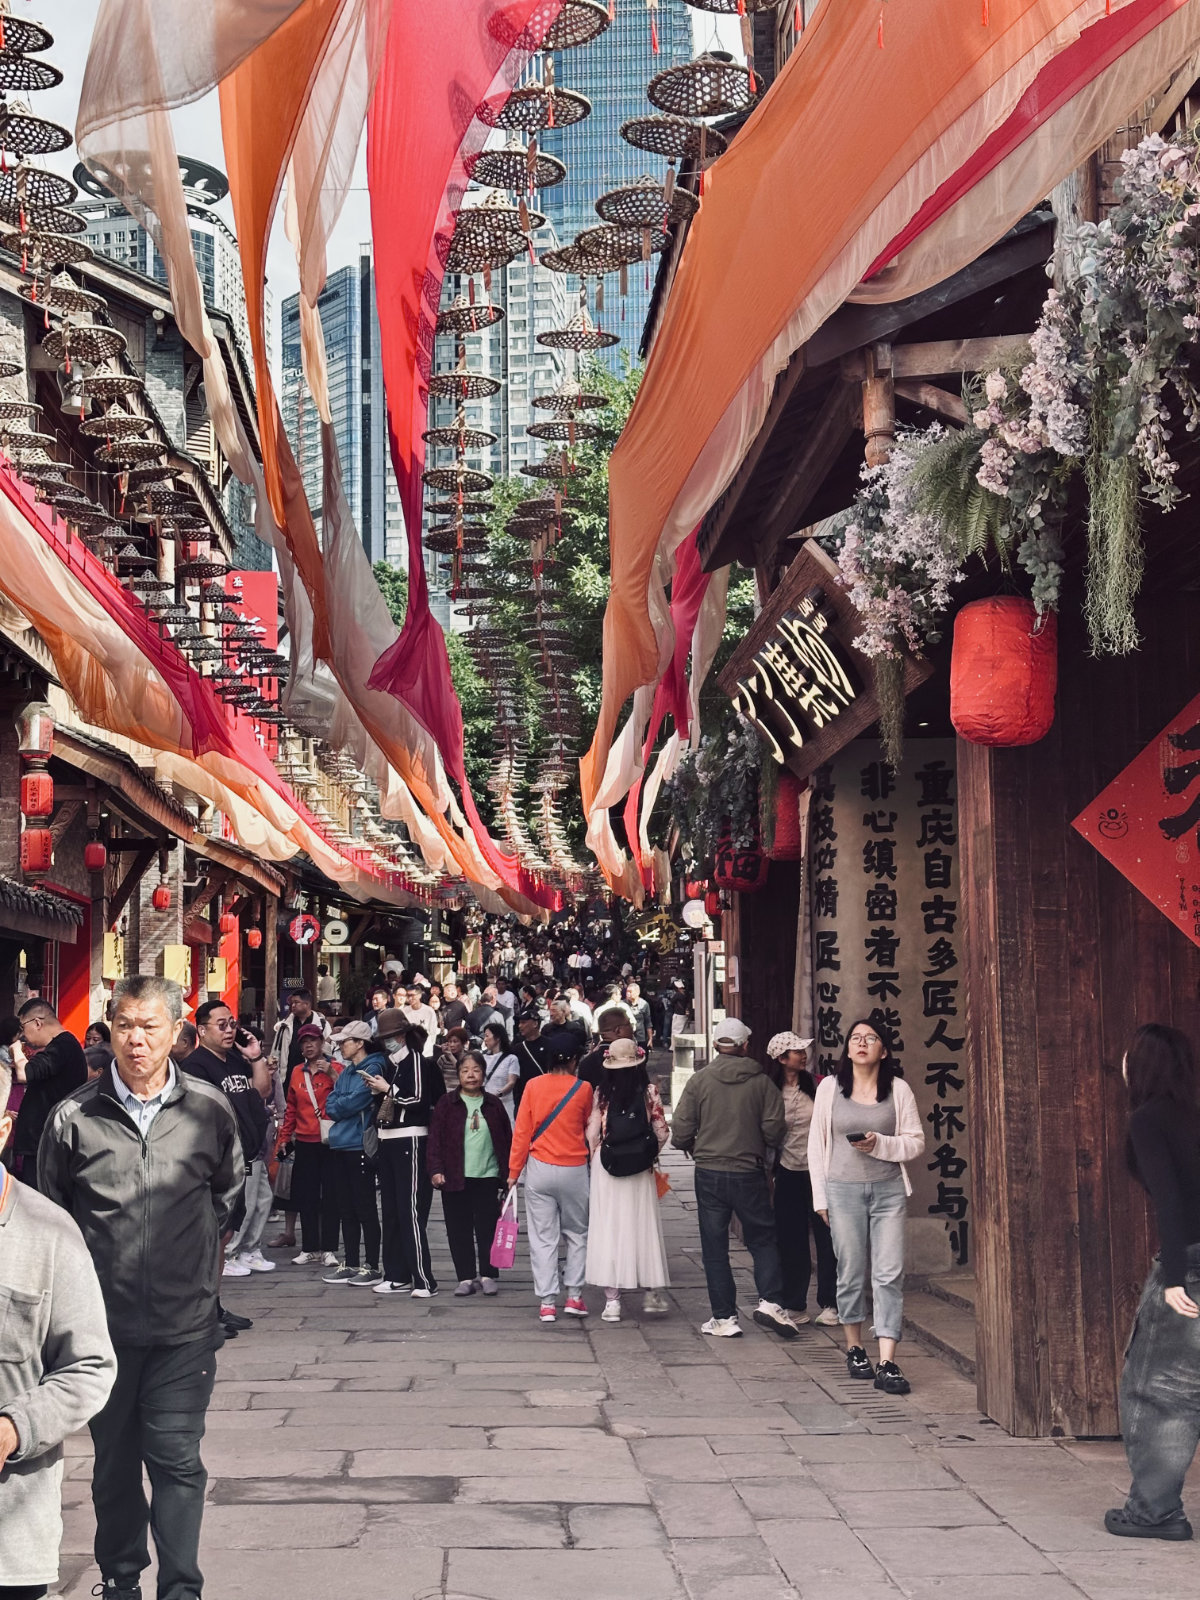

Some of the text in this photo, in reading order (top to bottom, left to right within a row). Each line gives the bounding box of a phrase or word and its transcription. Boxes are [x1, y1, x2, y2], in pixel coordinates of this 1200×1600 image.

[859, 762, 905, 1077] 非心缜密者不能
